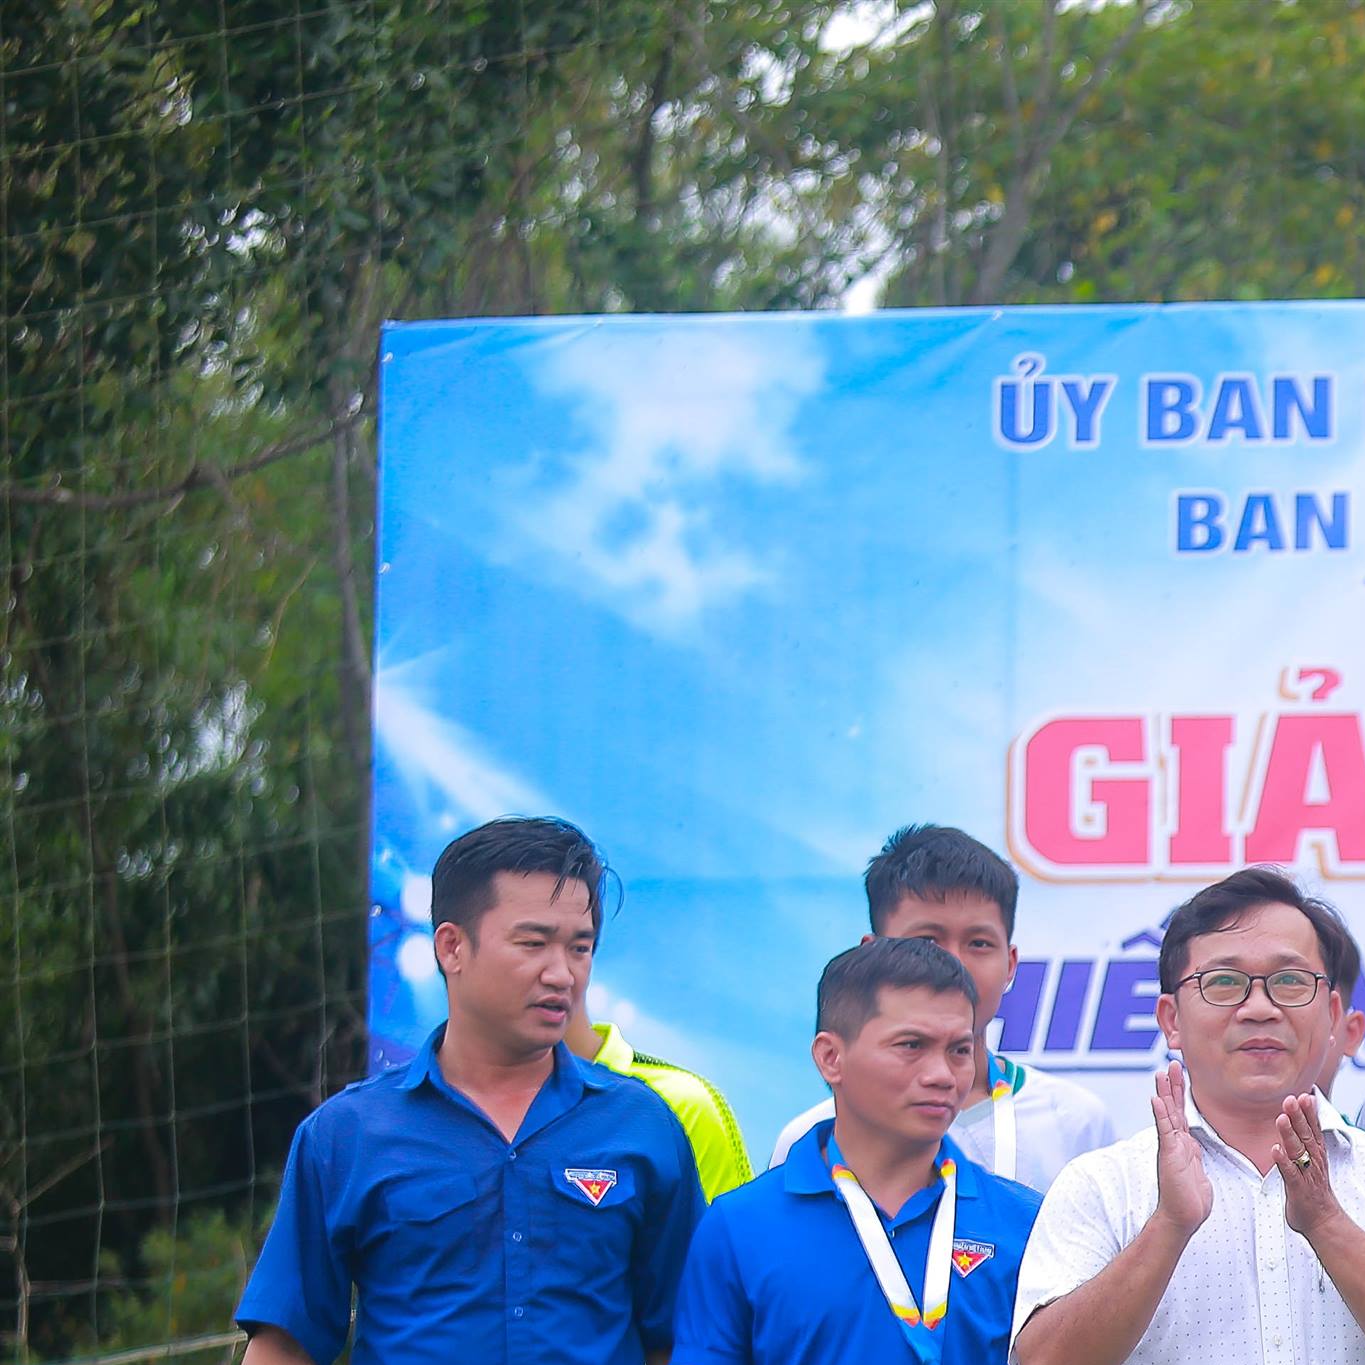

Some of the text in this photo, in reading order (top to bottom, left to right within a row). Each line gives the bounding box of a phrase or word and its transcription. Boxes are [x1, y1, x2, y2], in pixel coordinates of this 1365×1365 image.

[998, 356, 1111, 444] ỦY
[1146, 375, 1331, 442] BAN
[1177, 492, 1348, 552] BAN
